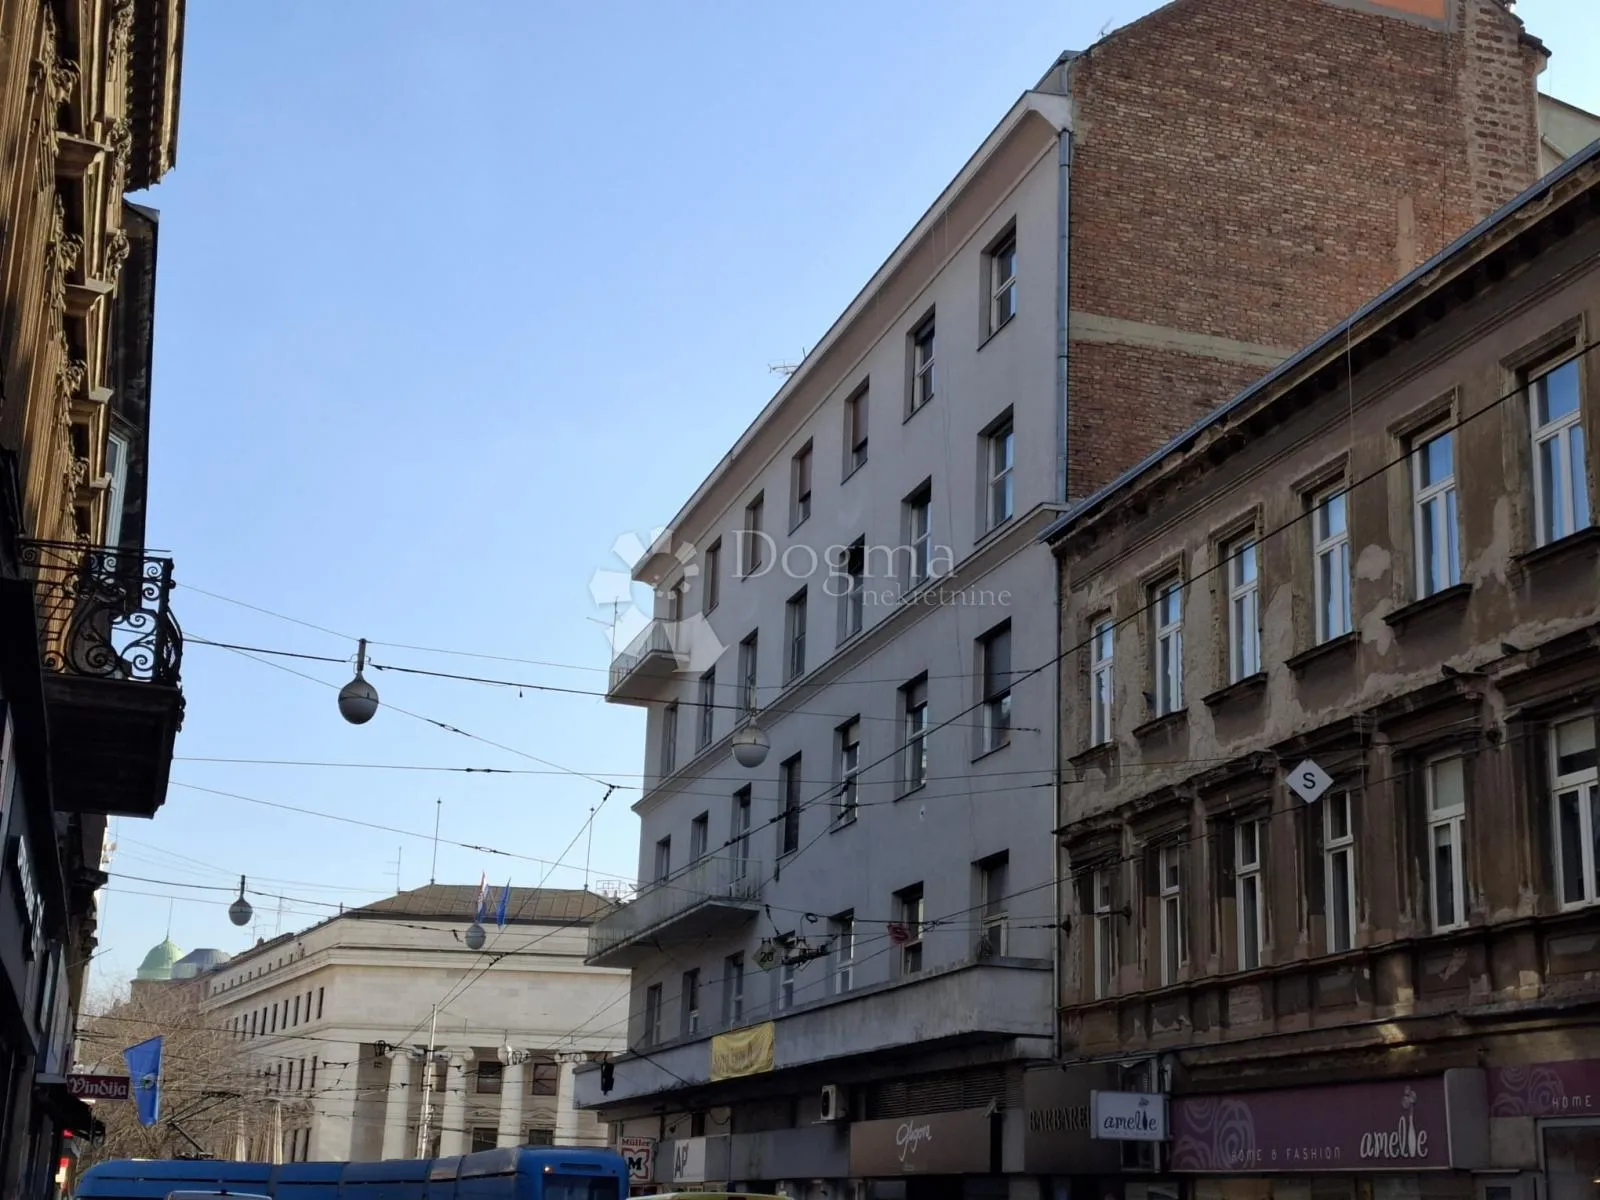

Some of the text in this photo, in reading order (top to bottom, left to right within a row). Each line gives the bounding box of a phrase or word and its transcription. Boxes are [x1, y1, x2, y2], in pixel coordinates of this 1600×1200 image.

[1302, 772, 1316, 789] S
[69, 1076, 127, 1097] Vindija
[1103, 1109, 1158, 1131] amelie
[621, 1137, 652, 1147] Müller
[1359, 1113, 1429, 1159] amelie
[1231, 1148, 1262, 1161] HOME
[1286, 1146, 1341, 1161] FASHION
